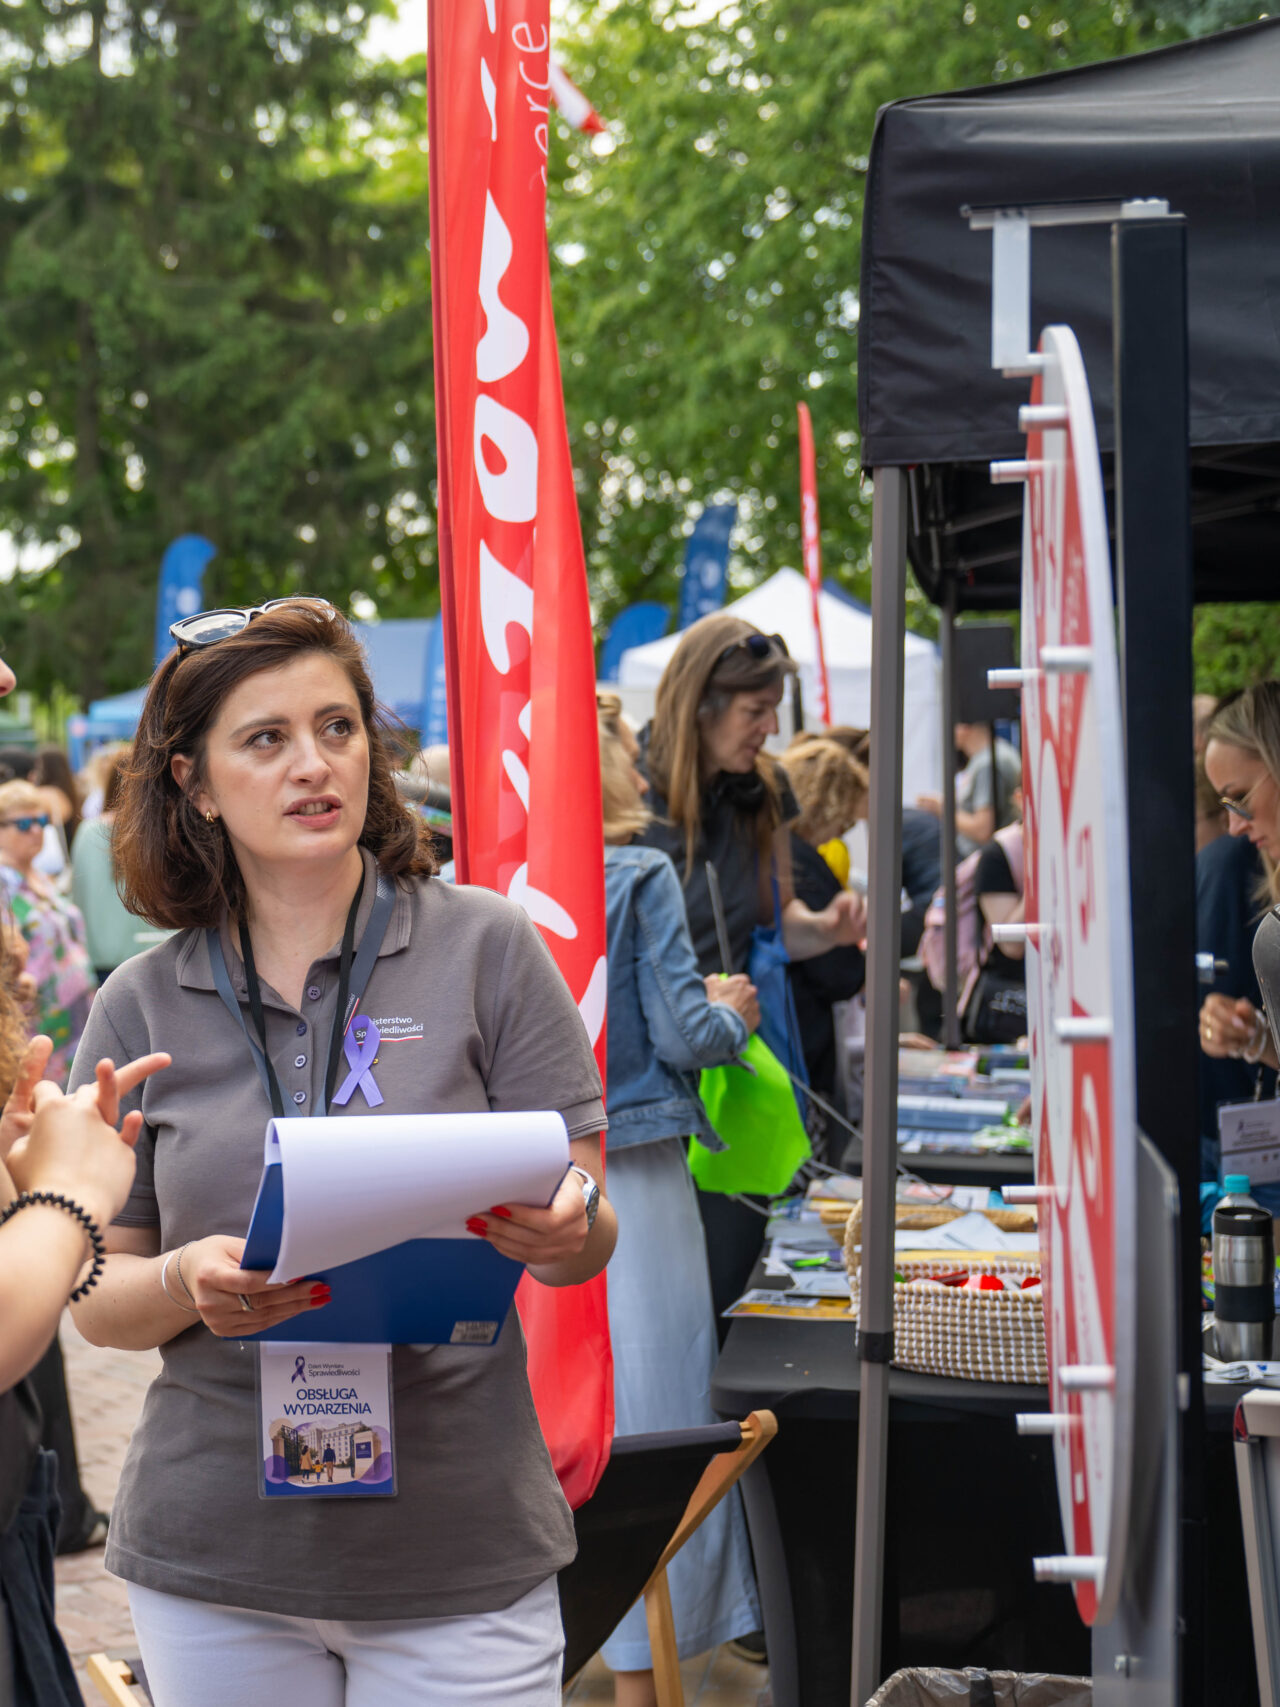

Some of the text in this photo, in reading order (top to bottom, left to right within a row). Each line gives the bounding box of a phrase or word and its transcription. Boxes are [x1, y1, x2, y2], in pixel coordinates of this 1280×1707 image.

[308, 1368, 361, 1377] Sprawiedliwości
[296, 1388, 358, 1400] OBSŁUGA
[283, 1402, 372, 1415] WYDARZENIA
